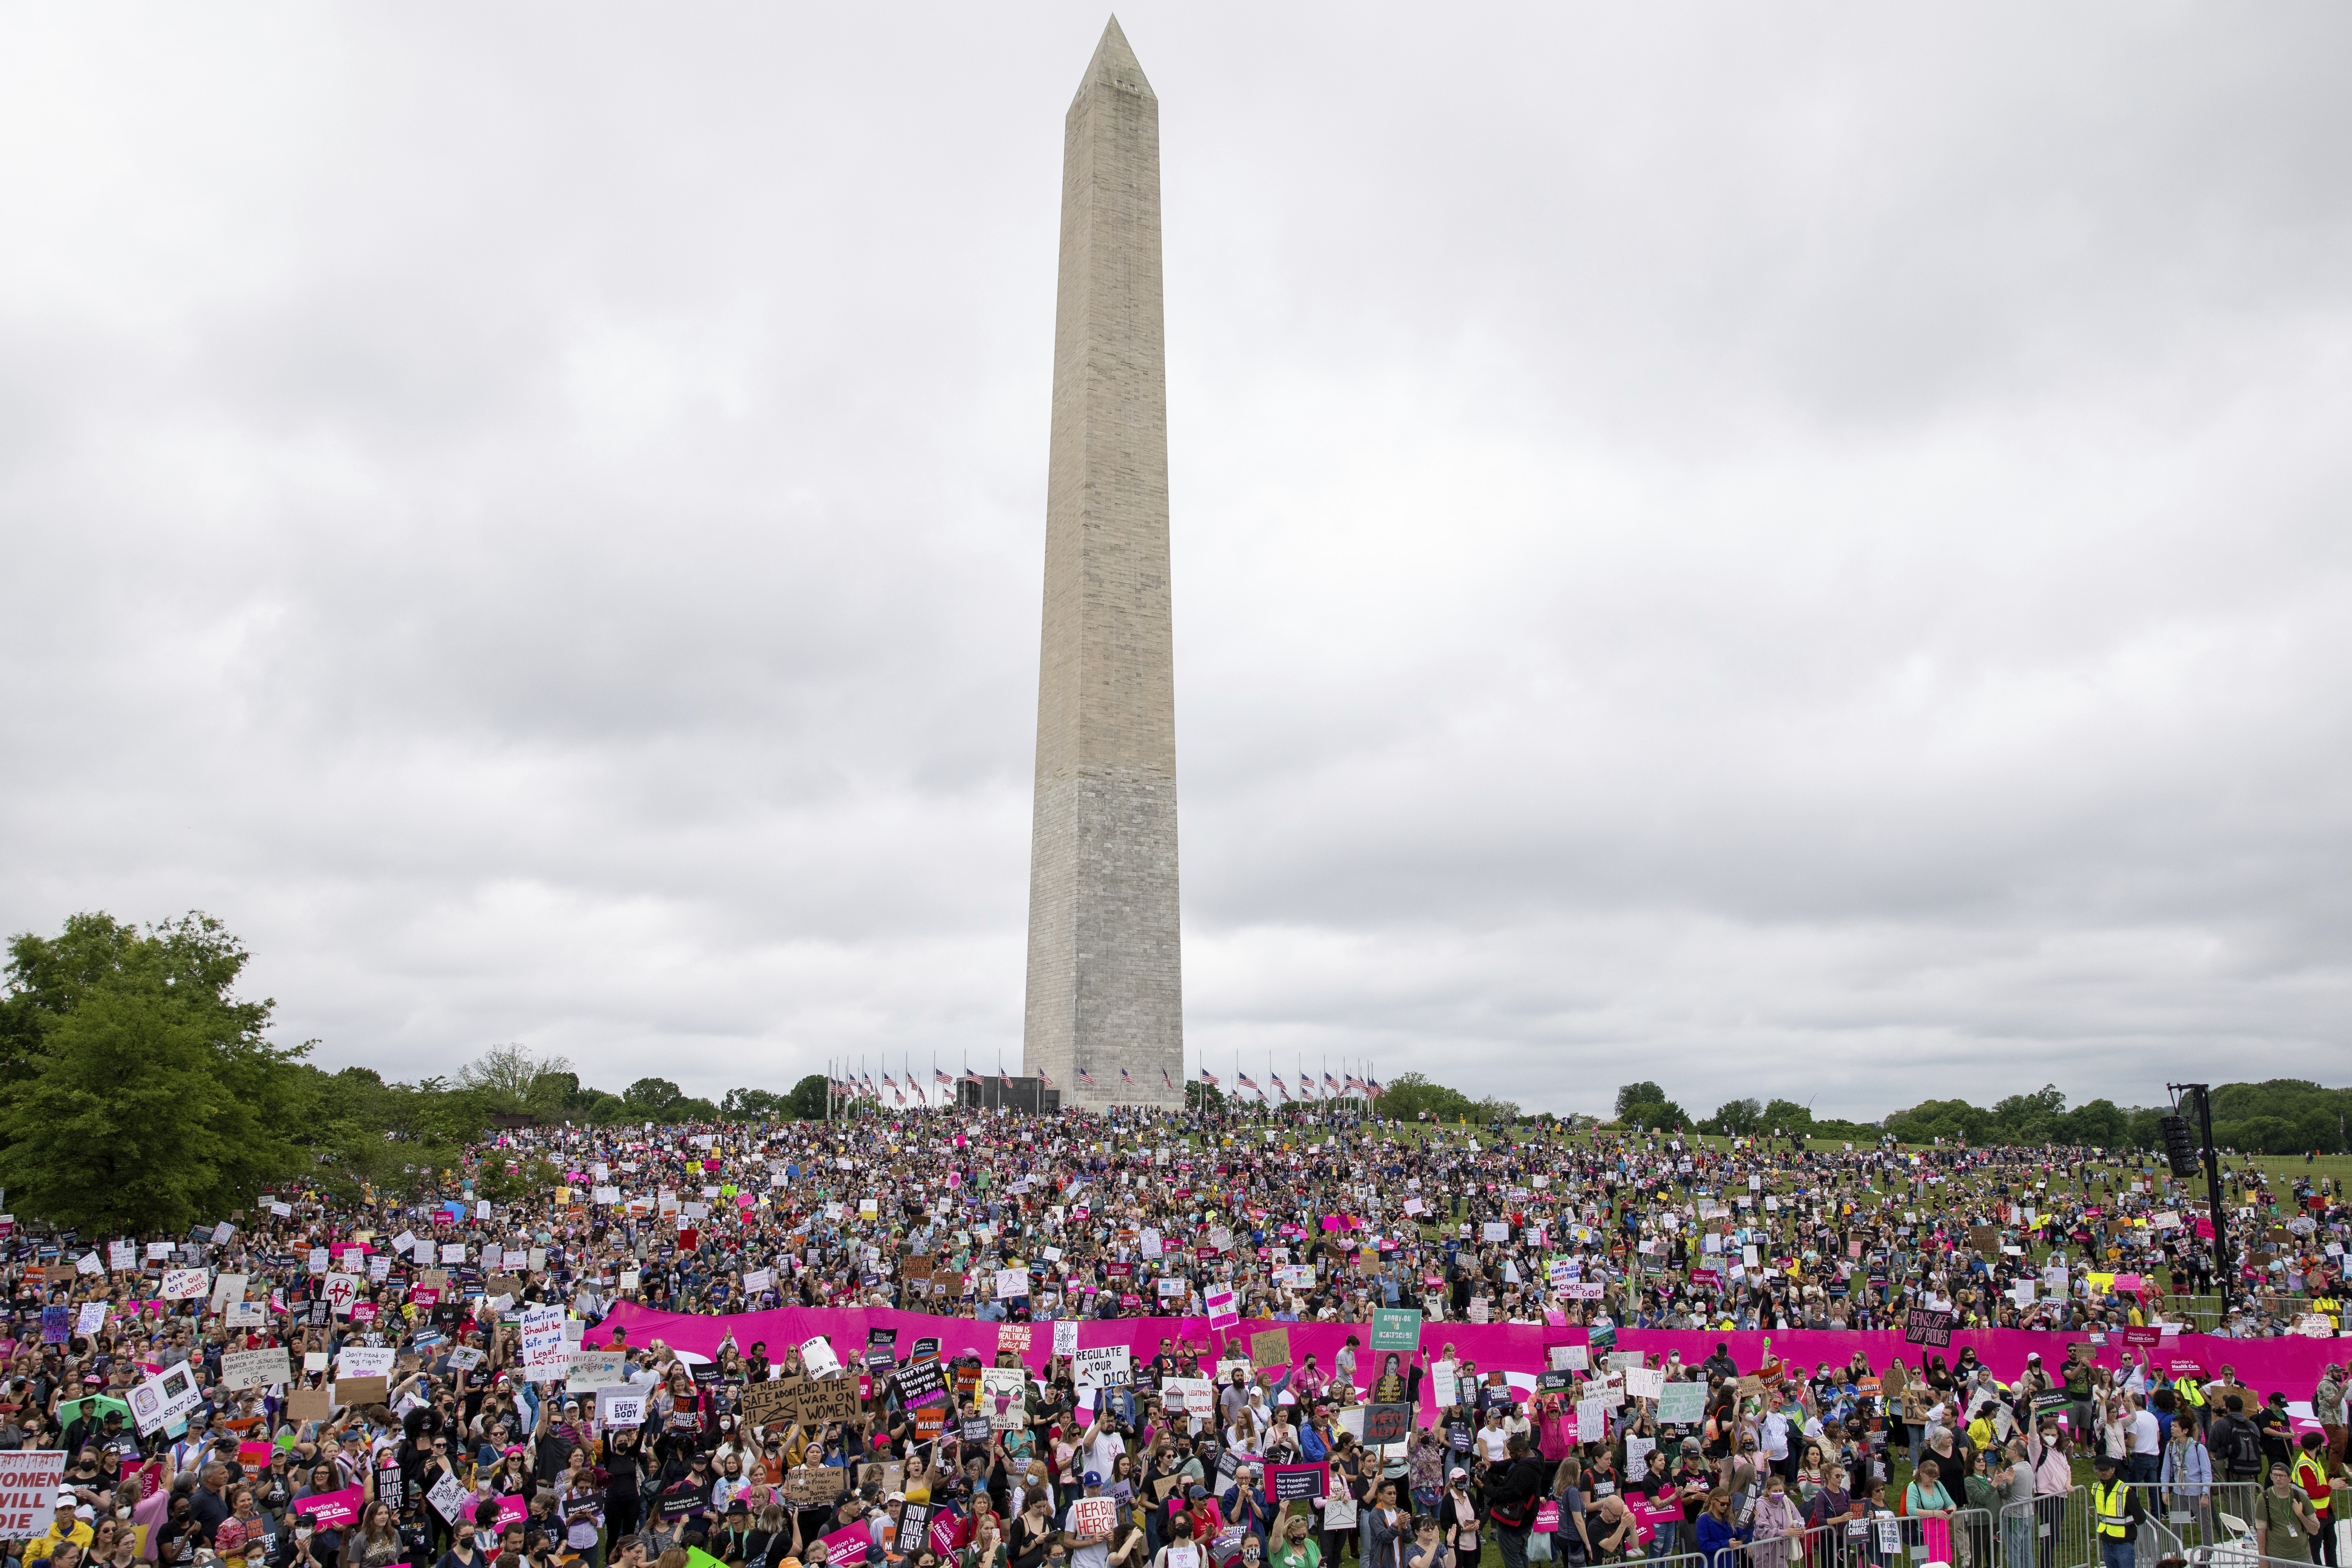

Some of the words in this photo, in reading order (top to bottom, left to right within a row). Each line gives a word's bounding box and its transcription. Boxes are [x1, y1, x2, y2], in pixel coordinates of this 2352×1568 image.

[168, 1271, 186, 1284] BANS
[168, 1284, 184, 1293] OFF
[188, 1274, 204, 1283] OUR
[181, 1281, 207, 1298] BODIES
[1210, 1284, 1229, 1296] PROE
[2052, 1288, 2067, 1296] SAFE
[314, 1301, 327, 1309] HOW
[1216, 1303, 1231, 1314] PROE
[312, 1309, 326, 1317] DARE
[524, 1311, 558, 1324] Abortion
[311, 1317, 325, 1325] THEY.
[1211, 1313, 1237, 1328] PRIVACY
[1910, 1311, 1931, 1326] BANS
[1932, 1314, 1951, 1328] OFF
[524, 1322, 549, 1335] Should
[552, 1320, 561, 1330] be
[1056, 1322, 1073, 1333] MY
[526, 1339, 541, 1348] Safe
[548, 1333, 562, 1343] and
[998, 1332, 1032, 1341] HEALTHCARE
[1908, 1328, 1925, 1341] OUR
[1926, 1328, 1948, 1345] BODIES
[533, 1344, 557, 1359] Legal!
[1019, 1341, 1030, 1350] ROE
[225, 1352, 258, 1362] MEMBERS
[1076, 1347, 1121, 1361] REGULATE
[224, 1362, 247, 1371] CHURCH
[235, 1365, 265, 1374] LATTER-DAY
[1089, 1361, 1111, 1372] YOUR
[243, 1375, 268, 1386] ROE
[1607, 1378, 1623, 1388] NOT
[742, 1384, 758, 1394] WE
[760, 1380, 785, 1391] NEED
[797, 1382, 819, 1395] END
[823, 1379, 850, 1391] THE
[743, 1392, 773, 1407] SAFE
[799, 1394, 828, 1405] WAR
[836, 1391, 855, 1402] ON
[140, 1415, 161, 1432] RUTH
[164, 1401, 184, 1418] SENT
[187, 1392, 197, 1404] US
[614, 1409, 638, 1418] BODY
[615, 1404, 638, 1412] EVERY
[805, 1401, 856, 1420] WOMEN
[1580, 1403, 1599, 1418] FOCUS
[673, 1411, 696, 1421] PROTECT
[1372, 1413, 1404, 1423] VETO
[672, 1418, 694, 1427] CHOICE.
[1368, 1426, 1405, 1437] ALITO
[907, 1504, 926, 1521] HOW
[1075, 1501, 1100, 1519] HER
[1100, 1501, 1116, 1516] BODY
[902, 1521, 925, 1536] DARE
[1078, 1518, 1102, 1535] HER
[1848, 1518, 1869, 1528] PROTECT
